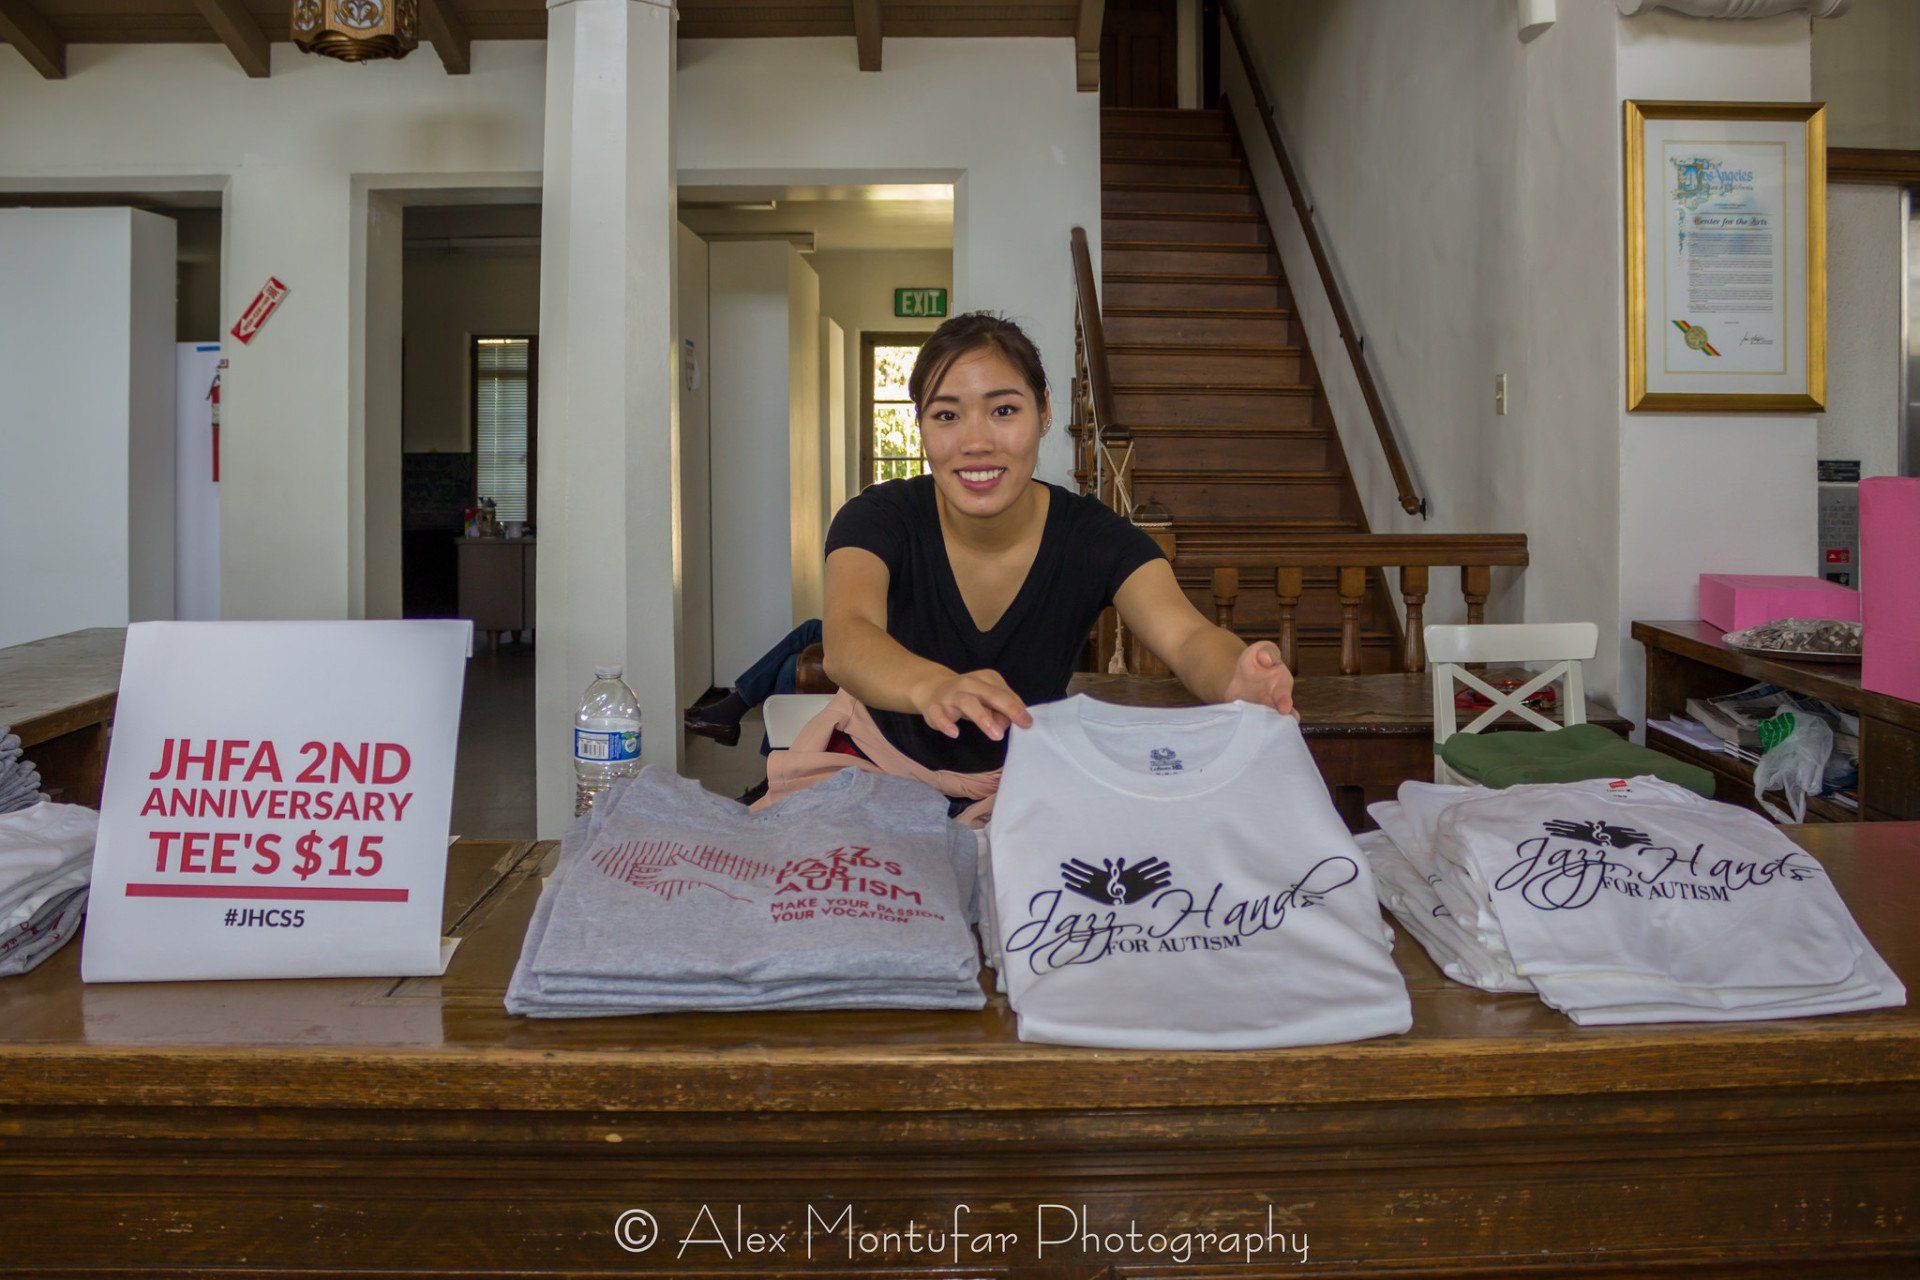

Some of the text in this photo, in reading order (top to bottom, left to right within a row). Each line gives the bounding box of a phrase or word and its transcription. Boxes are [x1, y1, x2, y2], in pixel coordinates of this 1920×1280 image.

[1694, 216, 1720, 226] Center
[1722, 217, 1733, 227] for
[1736, 216, 1748, 225] the
[902, 291, 940, 314] EXIT
[149, 739, 412, 785] JHFA 2ND
[140, 788, 413, 821] ANNIVERSARY
[149, 830, 384, 881] TEE'S $15
[1495, 837, 1821, 910] Jazz Hands
[774, 877, 921, 906] AUTISM
[1600, 875, 1731, 902] FOR AUTISM
[224, 909, 305, 927] #JHCS5
[771, 898, 945, 921] MAKE YOUR PASSION
[772, 907, 909, 923] YOUR VOCATION
[1006, 857, 1358, 975] Jazz Hands
[1108, 935, 1243, 955] FOR AUTISM
